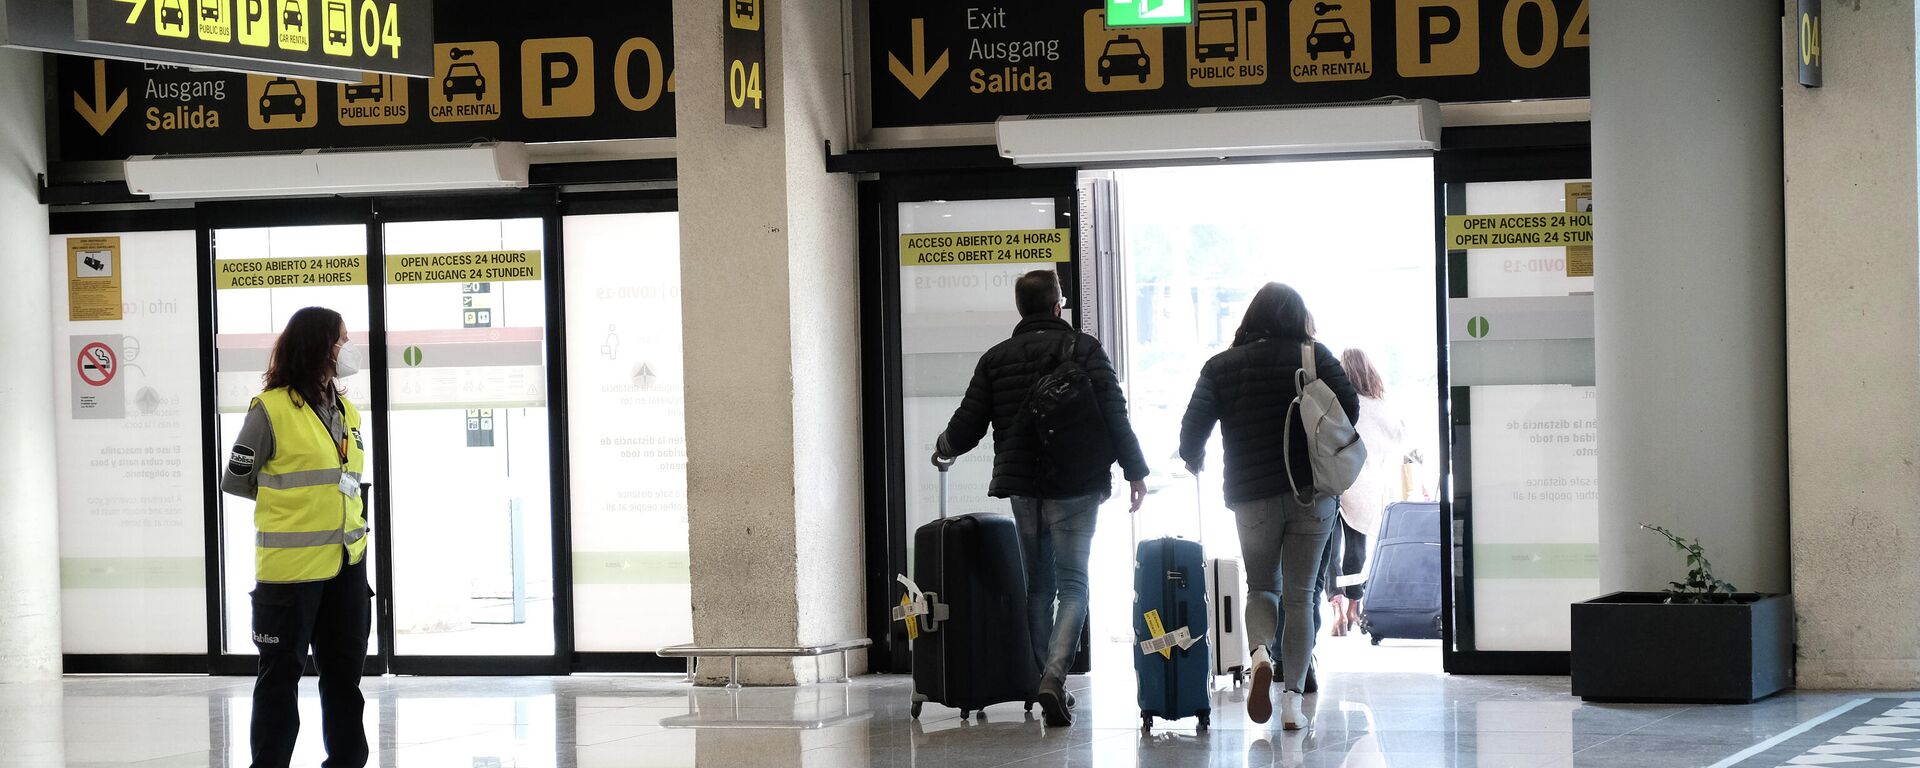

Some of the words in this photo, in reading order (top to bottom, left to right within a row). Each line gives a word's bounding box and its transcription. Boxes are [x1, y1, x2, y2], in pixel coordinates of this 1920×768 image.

[967, 8, 1006, 30] Exit
[199, 24, 218, 36] PUBLIC
[219, 26, 230, 37] BUS
[360, 0, 401, 58] 04
[1418, 5, 1462, 64] P
[279, 33, 289, 44] CAR
[289, 34, 308, 46] RENTAL
[1801, 12, 1820, 67] 04
[969, 37, 1060, 61] Ausgang
[614, 37, 675, 111] 0
[1190, 65, 1236, 80] PUBLIC
[1239, 63, 1265, 77] BUS
[1293, 63, 1318, 77] CAR
[1321, 61, 1370, 76] RENTAL
[541, 52, 578, 106] P
[730, 59, 762, 109] 04
[969, 65, 1052, 94] Salida
[145, 78, 226, 102] Ausgang
[145, 104, 219, 131] Salida
[340, 106, 380, 119] PUBLIC
[384, 105, 406, 117] BUS
[431, 105, 453, 117] CAR
[457, 103, 499, 117] RENTAL
[1463, 218, 1496, 230] OPEN
[1499, 217, 1547, 229] ACCESS
[1551, 216, 1565, 227] 24
[1570, 215, 1593, 226] HOU
[908, 237, 953, 249] ACCESO
[956, 235, 1003, 247] ABIERTO
[1006, 234, 1020, 245] 24
[1023, 232, 1061, 244] HORAS
[1455, 234, 1488, 246] OPEN
[1492, 232, 1540, 244] ZUGANG
[1544, 232, 1559, 243] 24
[1563, 231, 1593, 242] STUN
[401, 256, 429, 267] OPEN
[431, 254, 473, 266] ACCESS
[474, 253, 488, 265] 24
[490, 252, 526, 265] HOURS
[918, 249, 954, 263] ACCÉS
[957, 250, 993, 261] OBERT
[997, 249, 1011, 260] 24
[1015, 248, 1052, 260] HORES
[222, 260, 263, 273] ACCESO
[265, 259, 307, 272] ABIERTO
[310, 258, 323, 270] 24
[325, 257, 360, 269] HORAS
[231, 272, 264, 286] ACCÉS
[267, 274, 299, 286] OBERT
[302, 273, 315, 284] 24
[317, 271, 352, 284] HORES
[394, 270, 423, 282] OPEN
[425, 269, 466, 281] ZUGANG
[469, 268, 483, 280] 24
[485, 267, 534, 279] STUNDEN
